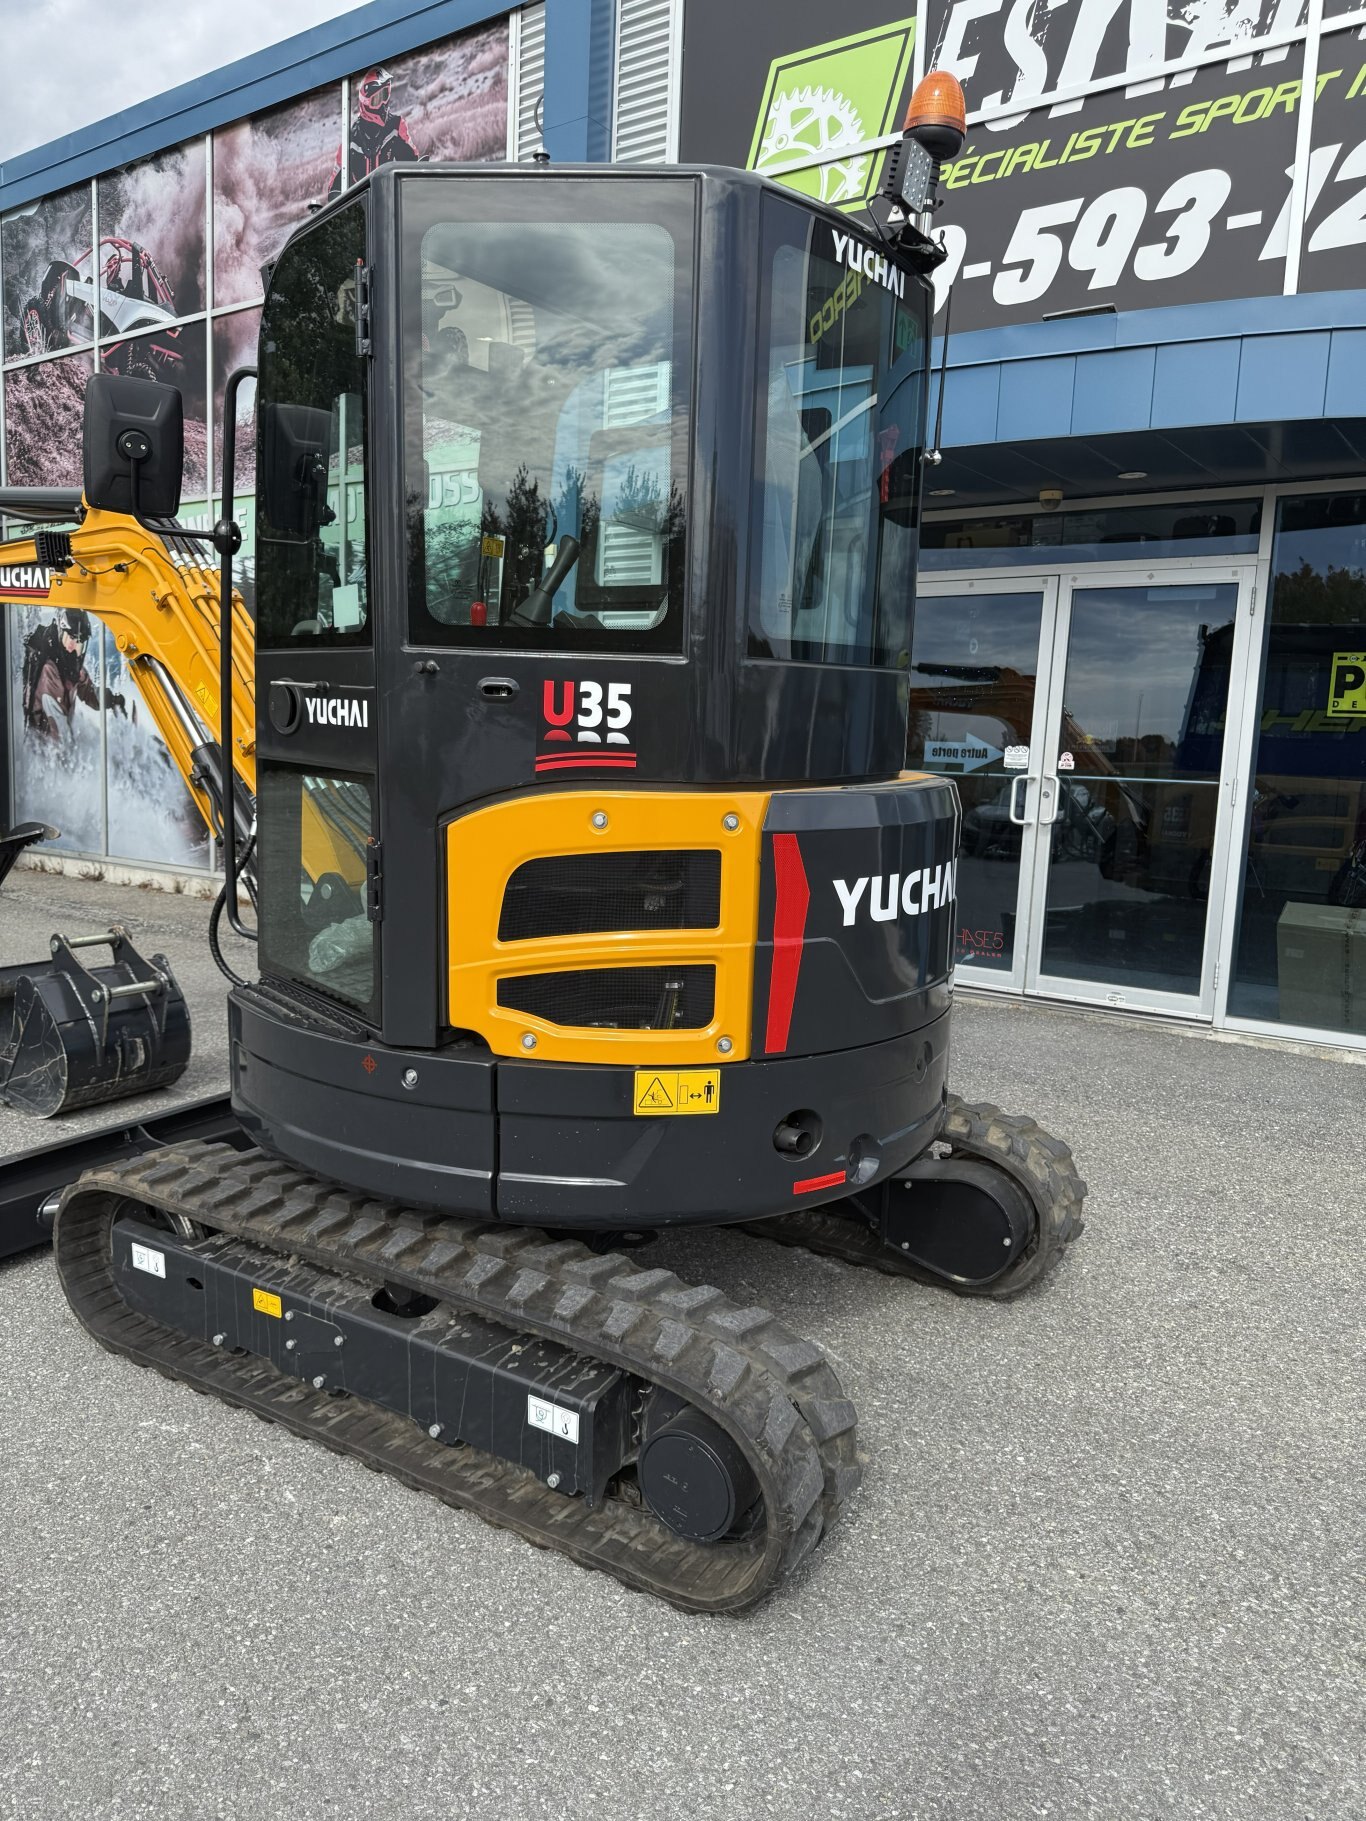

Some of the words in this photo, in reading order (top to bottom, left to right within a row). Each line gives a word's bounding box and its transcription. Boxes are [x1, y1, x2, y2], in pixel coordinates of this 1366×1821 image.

[1170, 69, 1343, 140] SPORT
[832, 229, 905, 299] YUCHAI
[305, 697, 369, 728] YUCHAI
[543, 680, 632, 729] U35
